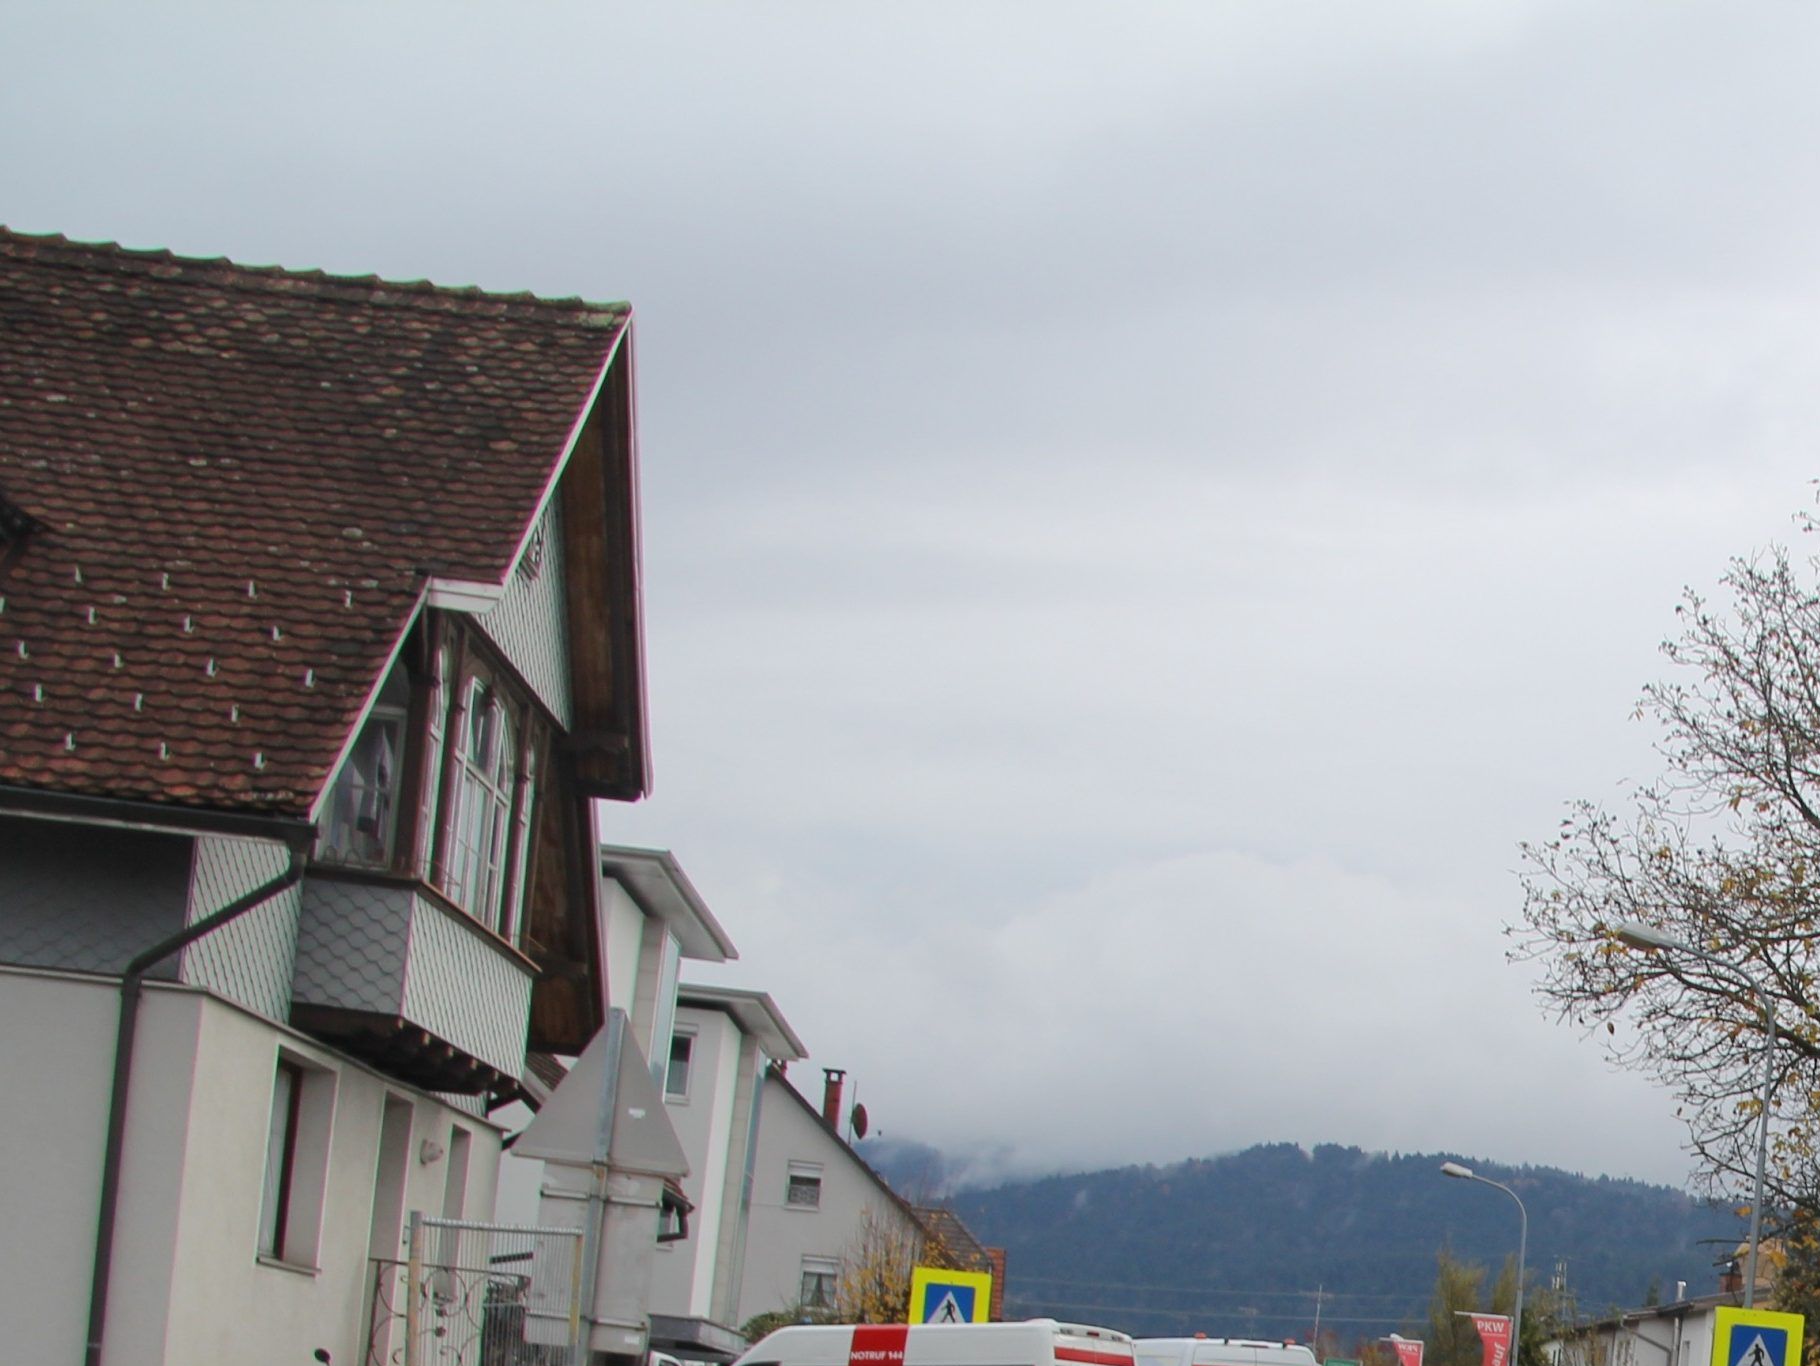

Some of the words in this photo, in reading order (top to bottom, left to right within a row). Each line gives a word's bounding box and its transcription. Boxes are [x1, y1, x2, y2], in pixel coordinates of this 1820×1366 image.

[1477, 1320, 1505, 1333] PKW
[851, 1350, 886, 1360] NOTRUF
[888, 1350, 903, 1360] 144
